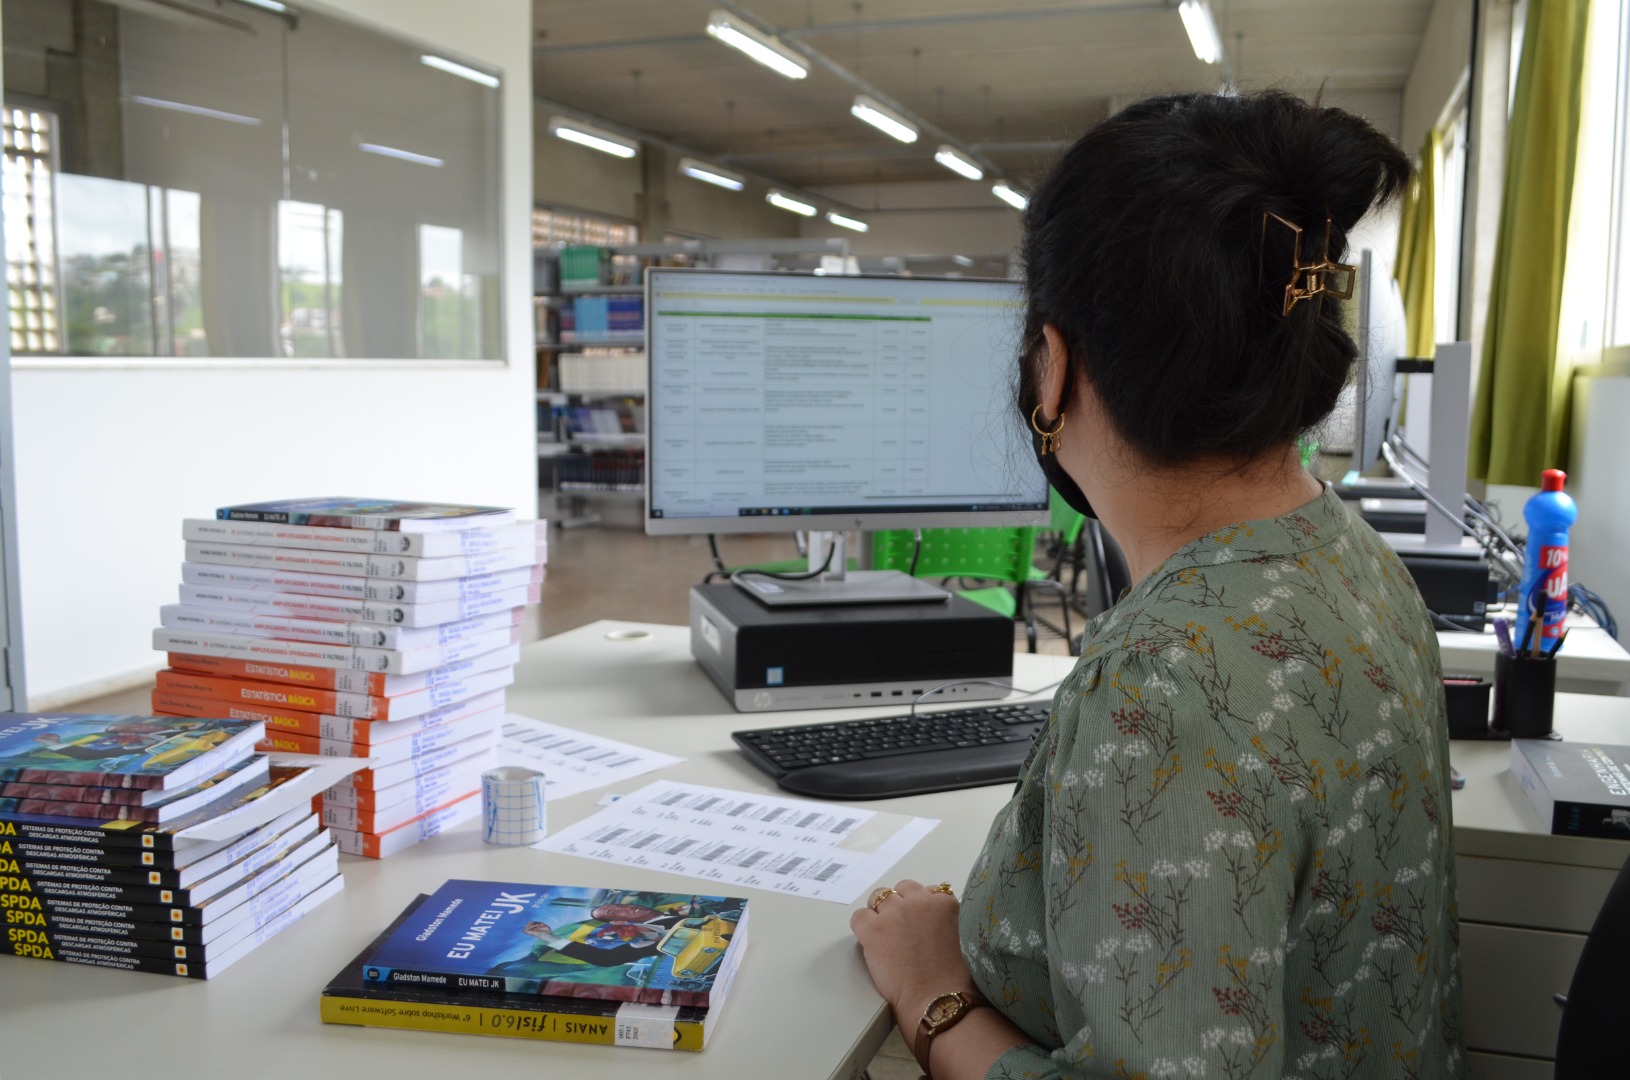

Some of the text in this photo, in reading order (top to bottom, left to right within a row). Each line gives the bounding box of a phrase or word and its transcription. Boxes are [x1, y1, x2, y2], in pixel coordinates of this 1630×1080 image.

[245, 662, 316, 682] ESTATÍSTICA BÁSICA
[241, 687, 316, 706] ESTATÍSTICA BÁSICA
[274, 714, 300, 728] BÁSICA
[274, 738, 300, 751] BÁSICA
[29, 832, 98, 843] DESCARGAS ATMOSFÉRICAS
[54, 827, 82, 836] PROTEÇÃO
[84, 830, 106, 838] CONTRA
[18, 843, 44, 851] SISTEMAS
[52, 846, 82, 854] PROTEÇÃO
[82, 848, 104, 856] CONTRA
[26, 850, 98, 861] DESCARGAS ATMOSFÉRICAS
[26, 862, 50, 870] SISTEMAS
[60, 864, 88, 873] PROTEÇÃO
[33, 870, 104, 880] DESCARGAS ATMOSFÉRICAS
[37, 880, 62, 888] SISTEMAS
[70, 883, 100, 892] PROTEÇÃO
[100, 886, 124, 894] CONTRA
[44, 888, 116, 899] DESCARGAS ATMOSFÉRICAS
[0, 894, 42, 910] SPDA
[81, 902, 110, 910] PROTEÇÃO
[110, 904, 134, 912] CONTRA
[6, 910, 47, 926] SPDA
[54, 906, 126, 918] DESCARGAS ATMOSFÉRICAS
[52, 916, 76, 924] SISTEMAS
[84, 918, 112, 927] PROTEÇÃO
[416, 898, 464, 942] Gladston Mamede
[446, 892, 536, 959] EU MATEI JK
[59, 922, 128, 935] DESCARGAS ATMOSFÉRICAS
[8, 928, 50, 944] SPDA
[54, 934, 78, 942] SISTEMAS
[87, 937, 115, 946] PROTEÇÃO
[116, 940, 138, 948] CONTRA
[14, 942, 54, 960] SPDA
[62, 941, 132, 954] DESCARGAS ATMOSFÉRICAS
[58, 950, 82, 958] SISTEMAS
[91, 952, 118, 962] PROTEÇÃO
[118, 956, 140, 964] CONTRA
[66, 956, 134, 970] DESCARGAS ATMOSFÉRICAS
[394, 972, 447, 984] Gladston Mamede
[458, 978, 500, 988] EU MATEI JK
[340, 1004, 360, 1013] Livre
[362, 1006, 397, 1016] Software
[399, 1008, 420, 1017] sobre
[422, 1010, 460, 1022] Workshop
[566, 1021, 608, 1036] ANAIS
